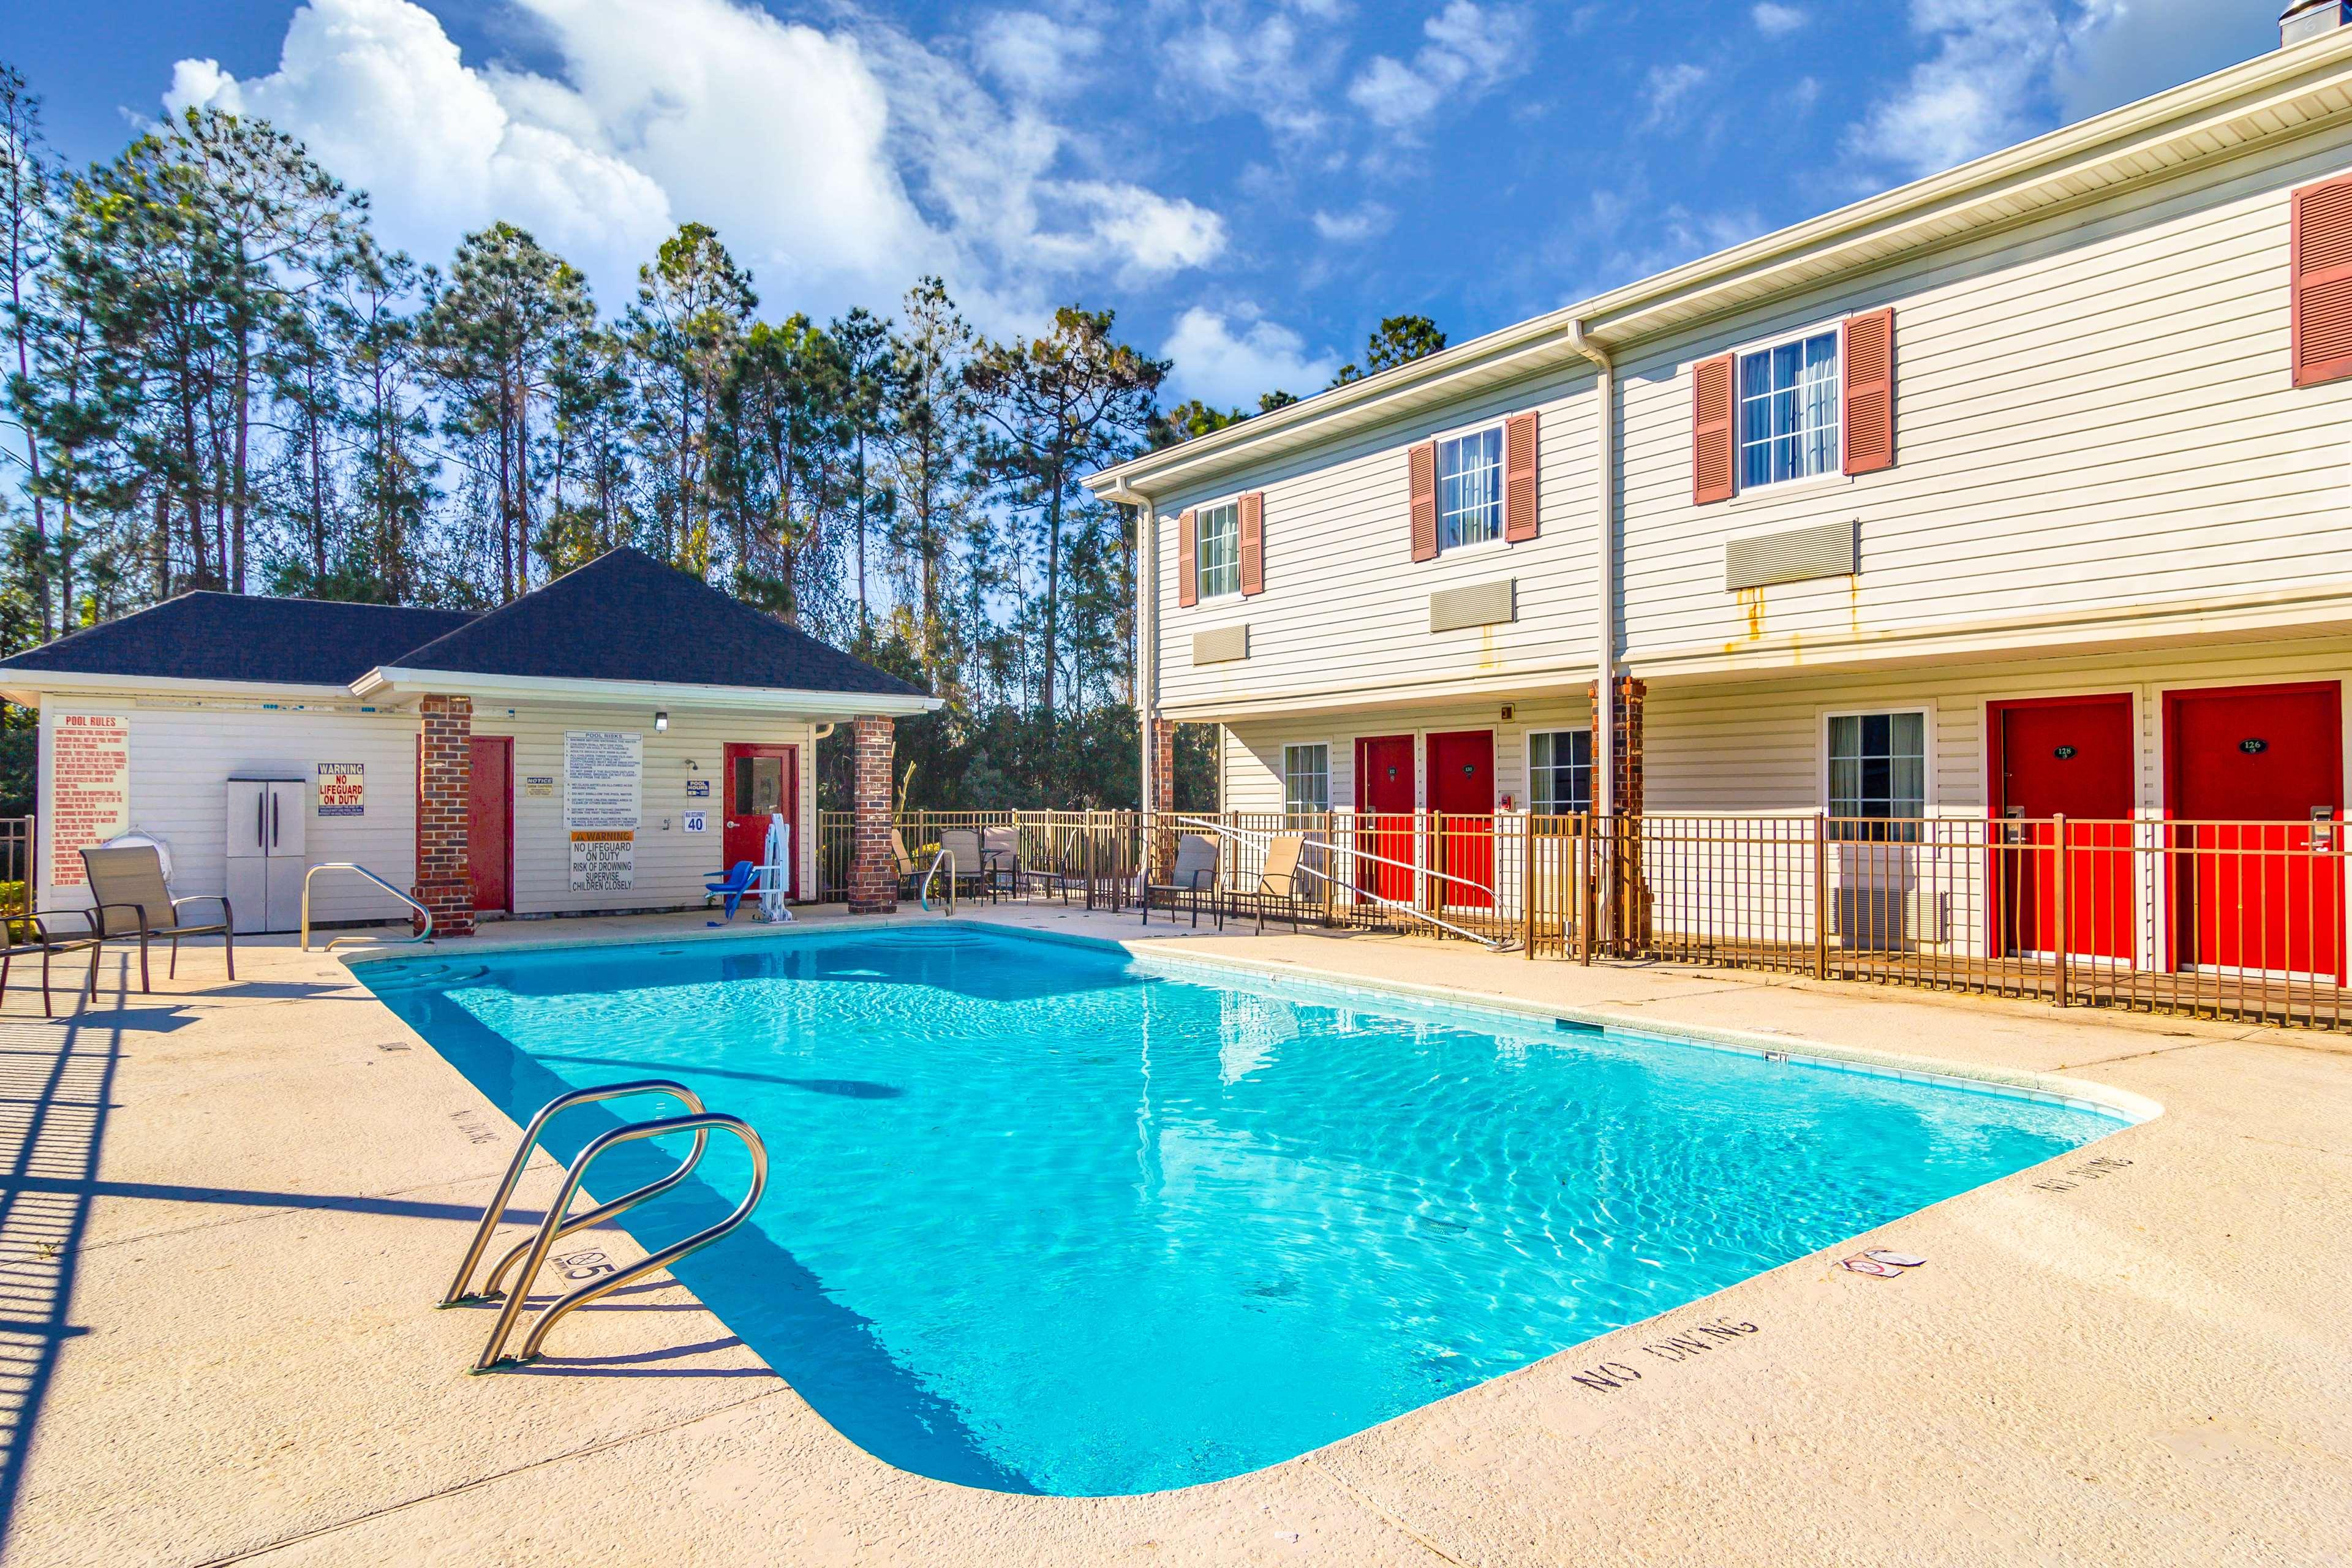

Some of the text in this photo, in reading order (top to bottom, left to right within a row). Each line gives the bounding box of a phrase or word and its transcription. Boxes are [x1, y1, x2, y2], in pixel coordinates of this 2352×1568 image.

[66, 716, 116, 726] POOL RULES
[320, 764, 363, 774] WARNING
[336, 775, 347, 784] NO
[320, 785, 363, 794] LIFEGUARD
[324, 795, 358, 804] ON DUTY
[688, 818, 703, 831] 40
[587, 832, 630, 841] WARNING
[574, 843, 631, 852] NO LIFEGUARD
[586, 852, 620, 861] ON DUTY
[573, 861, 632, 872] RISK OF DROWNING
[586, 872, 619, 881] SUPERVISE
[573, 881, 631, 891] CHILDREN CLOSELY
[564, 1264, 616, 1280] 5
[1571, 1317, 1758, 1393] NO DIVNG
